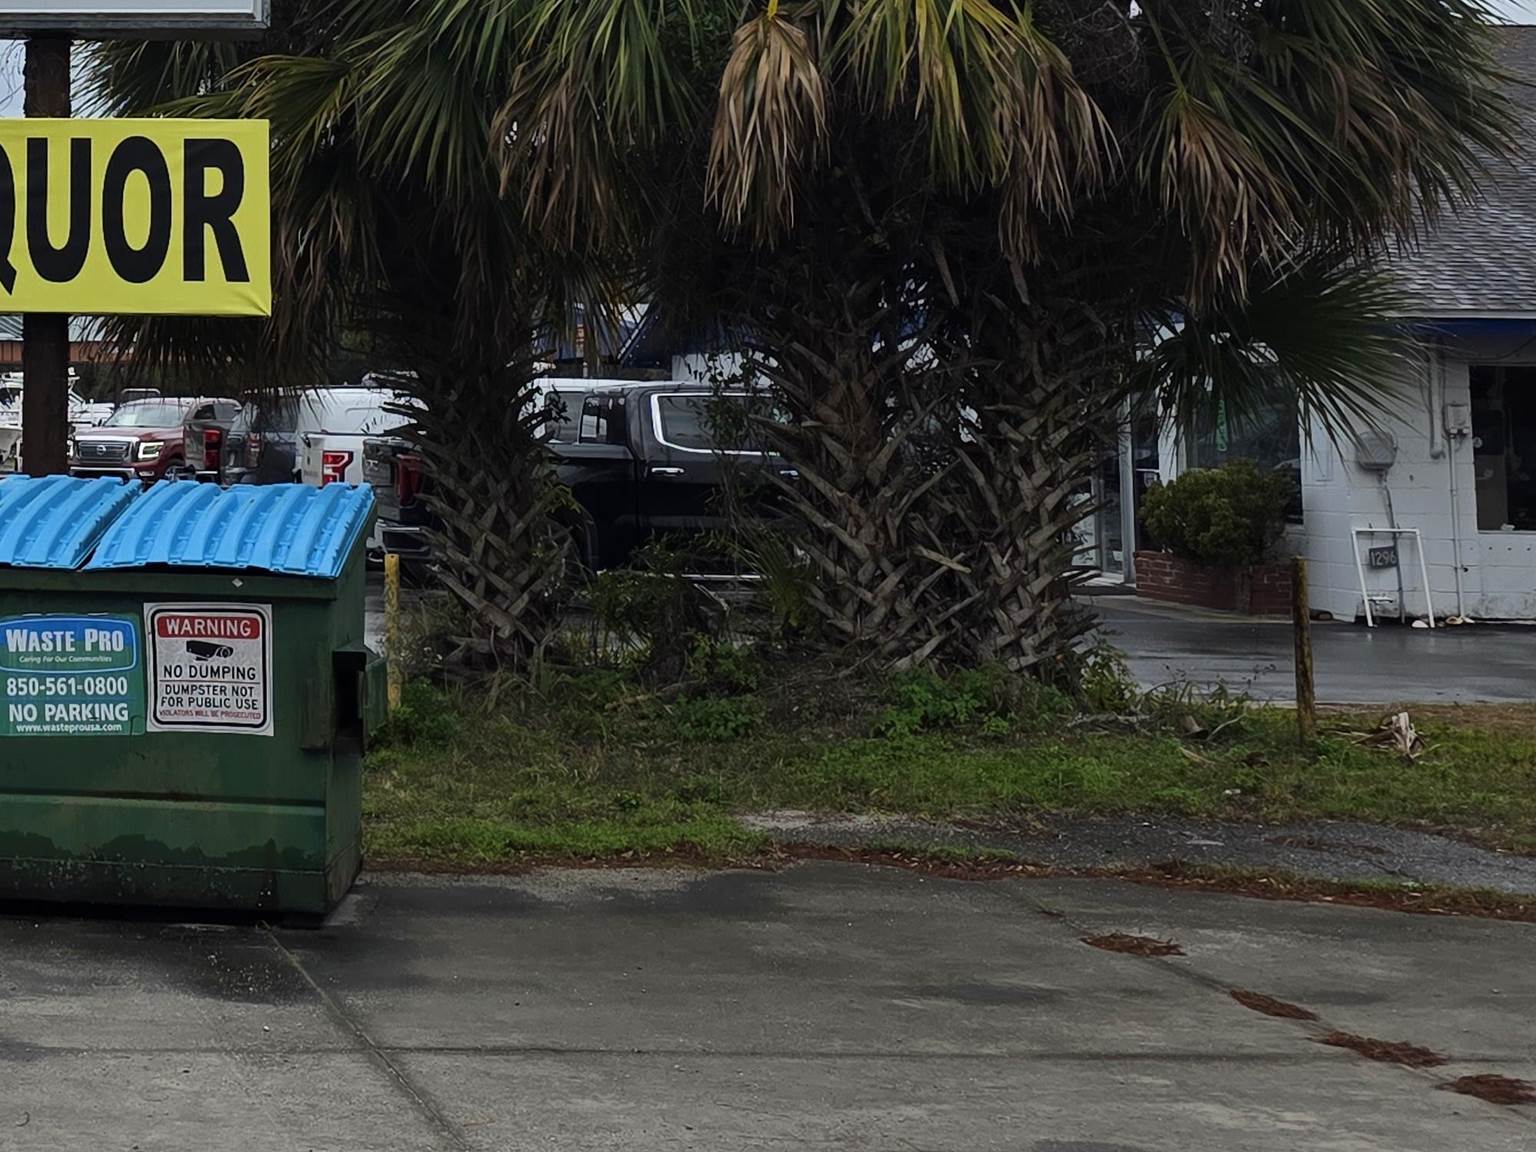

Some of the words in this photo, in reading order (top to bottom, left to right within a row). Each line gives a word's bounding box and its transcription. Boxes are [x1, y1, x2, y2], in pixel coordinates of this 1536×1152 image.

[1370, 551, 1398, 567] 1296
[166, 618, 252, 637] WARNING
[19, 655, 41, 664] Caring
[54, 655, 67, 663] Our
[68, 655, 113, 663] Communities
[164, 665, 183, 678] NO
[189, 665, 256, 680] DUMPING
[6, 676, 128, 696] 850-561-0800
[165, 684, 227, 696] DUMPSTER
[232, 685, 254, 697] NOT
[161, 696, 184, 707] FOR
[188, 697, 231, 708] PUBLIC
[235, 698, 259, 710] USE
[9, 704, 38, 722] NO
[44, 703, 129, 722] PARKING
[16, 722, 123, 733] www.wasteprousa.com
